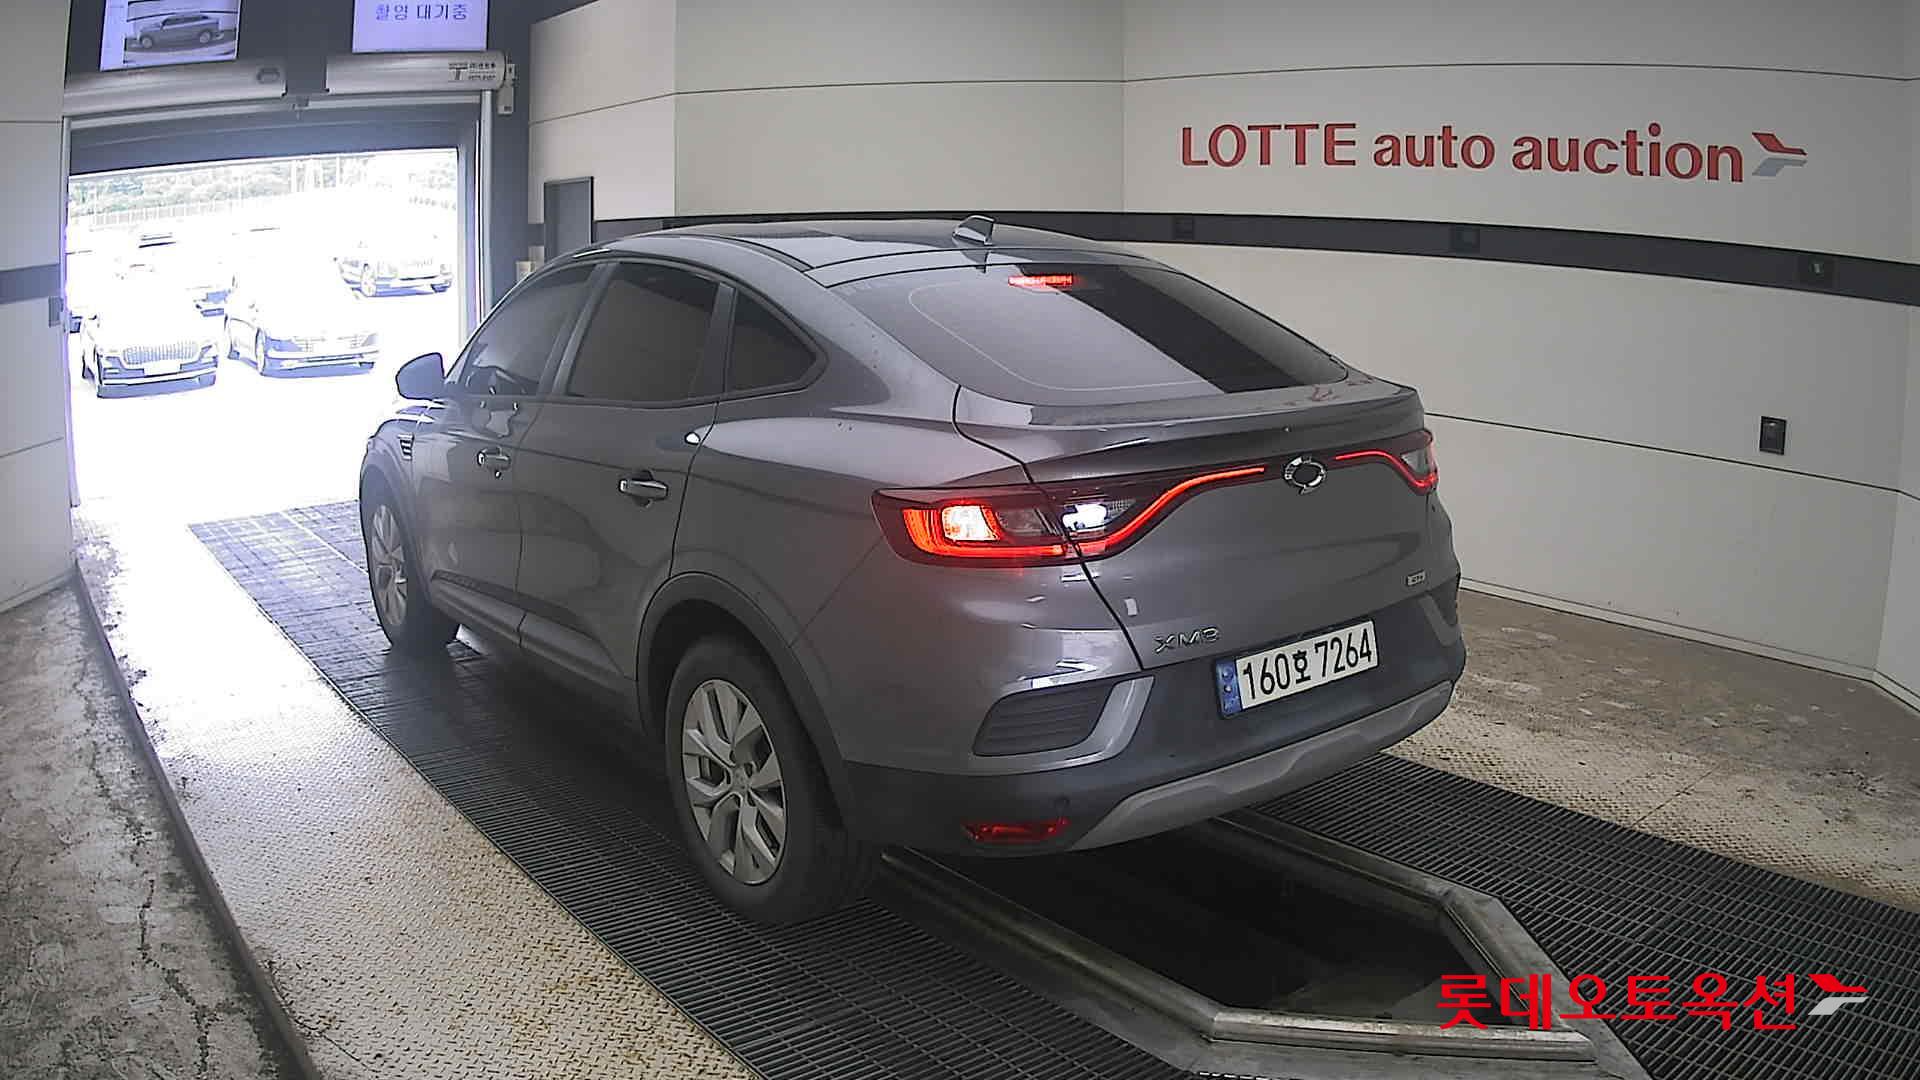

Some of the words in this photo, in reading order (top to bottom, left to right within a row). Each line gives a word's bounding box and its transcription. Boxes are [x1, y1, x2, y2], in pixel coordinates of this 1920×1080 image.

[416, 4, 467, 20] 대기중
[1182, 123, 1356, 167] LOTTE
[1373, 125, 1495, 169] auto
[1512, 122, 1743, 182] auction
